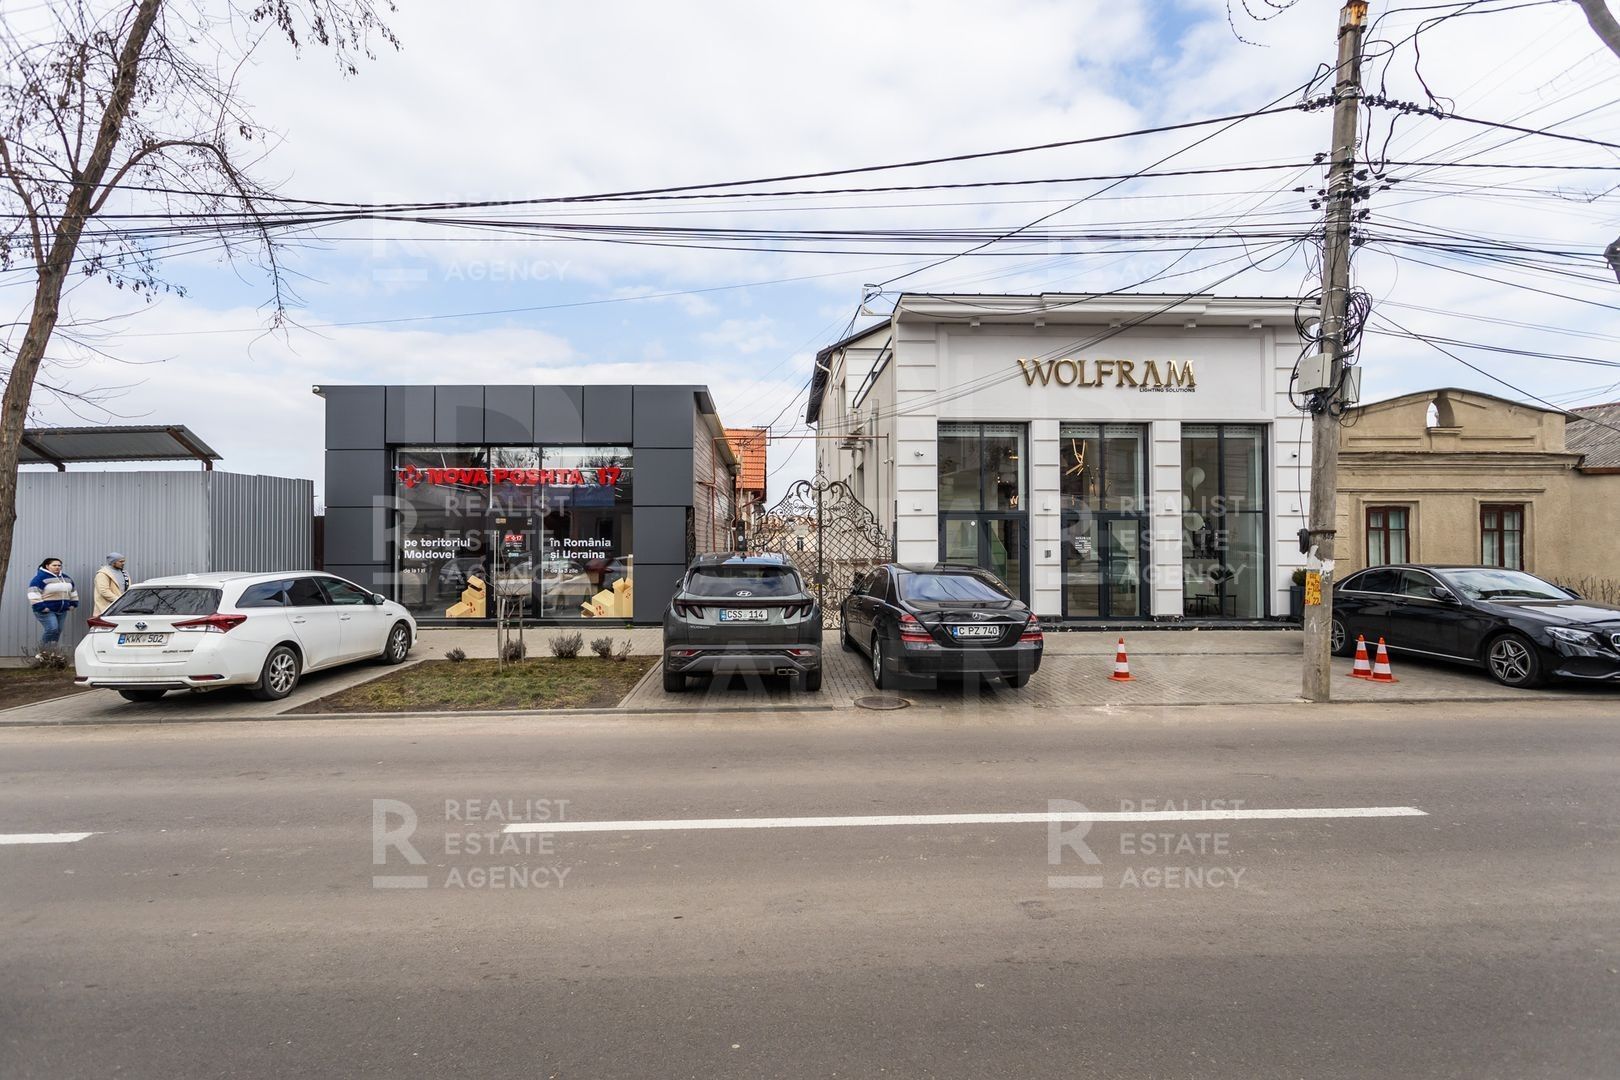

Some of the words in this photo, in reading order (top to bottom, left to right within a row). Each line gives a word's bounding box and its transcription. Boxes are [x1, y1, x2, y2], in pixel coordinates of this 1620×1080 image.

[1017, 358, 1197, 388] WOLFRAM
[427, 468, 489, 484] NOVA
[493, 468, 584, 486] POSHTA
[596, 467, 621, 486] 17
[404, 540, 418, 548] pe
[420, 538, 470, 546] teritoriul
[550, 538, 560, 546] în
[564, 538, 611, 546] România
[404, 550, 455, 558] Moldovei
[550, 550, 560, 560] și
[563, 550, 605, 558] Ucraina
[125, 633, 142, 643] KWK
[148, 634, 164, 642] 502
